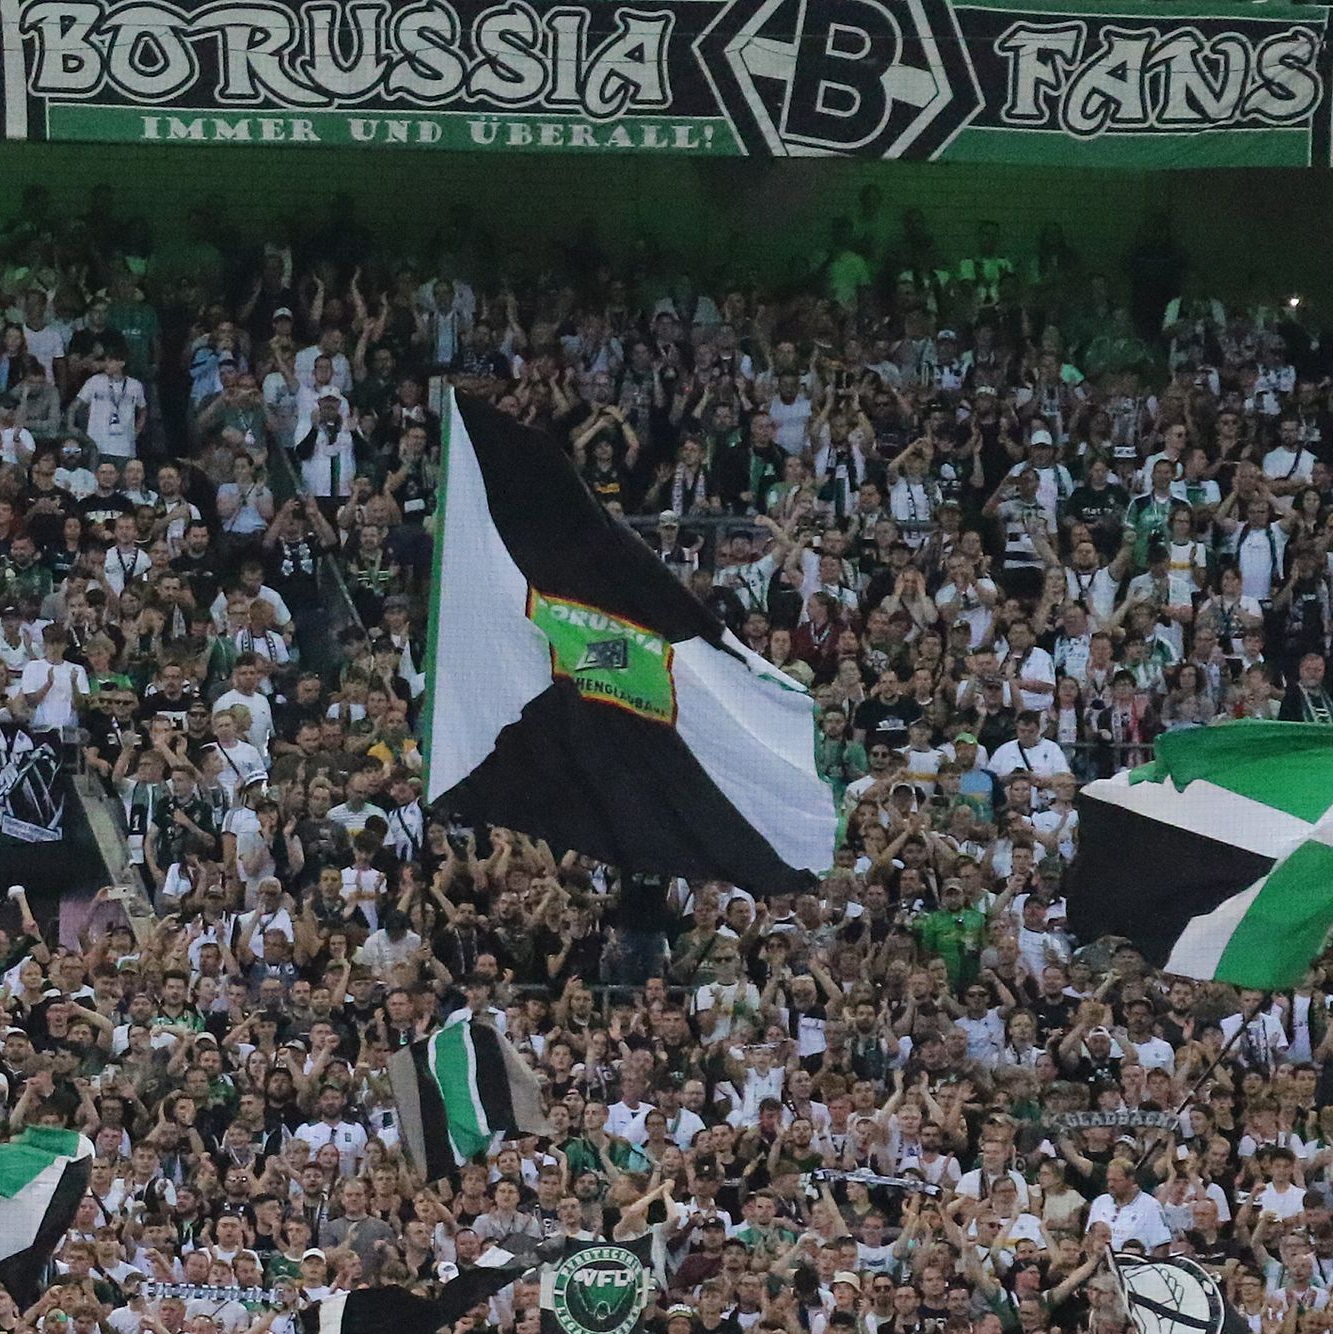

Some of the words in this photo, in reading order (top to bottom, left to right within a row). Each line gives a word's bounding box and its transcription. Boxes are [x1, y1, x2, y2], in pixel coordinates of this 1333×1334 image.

[29, 0, 672, 118] BORUSSIA
[994, 20, 1324, 137] FANS
[140, 114, 322, 143] IMMER
[348, 117, 444, 144] UND
[469, 115, 716, 149] ÜBERALL!
